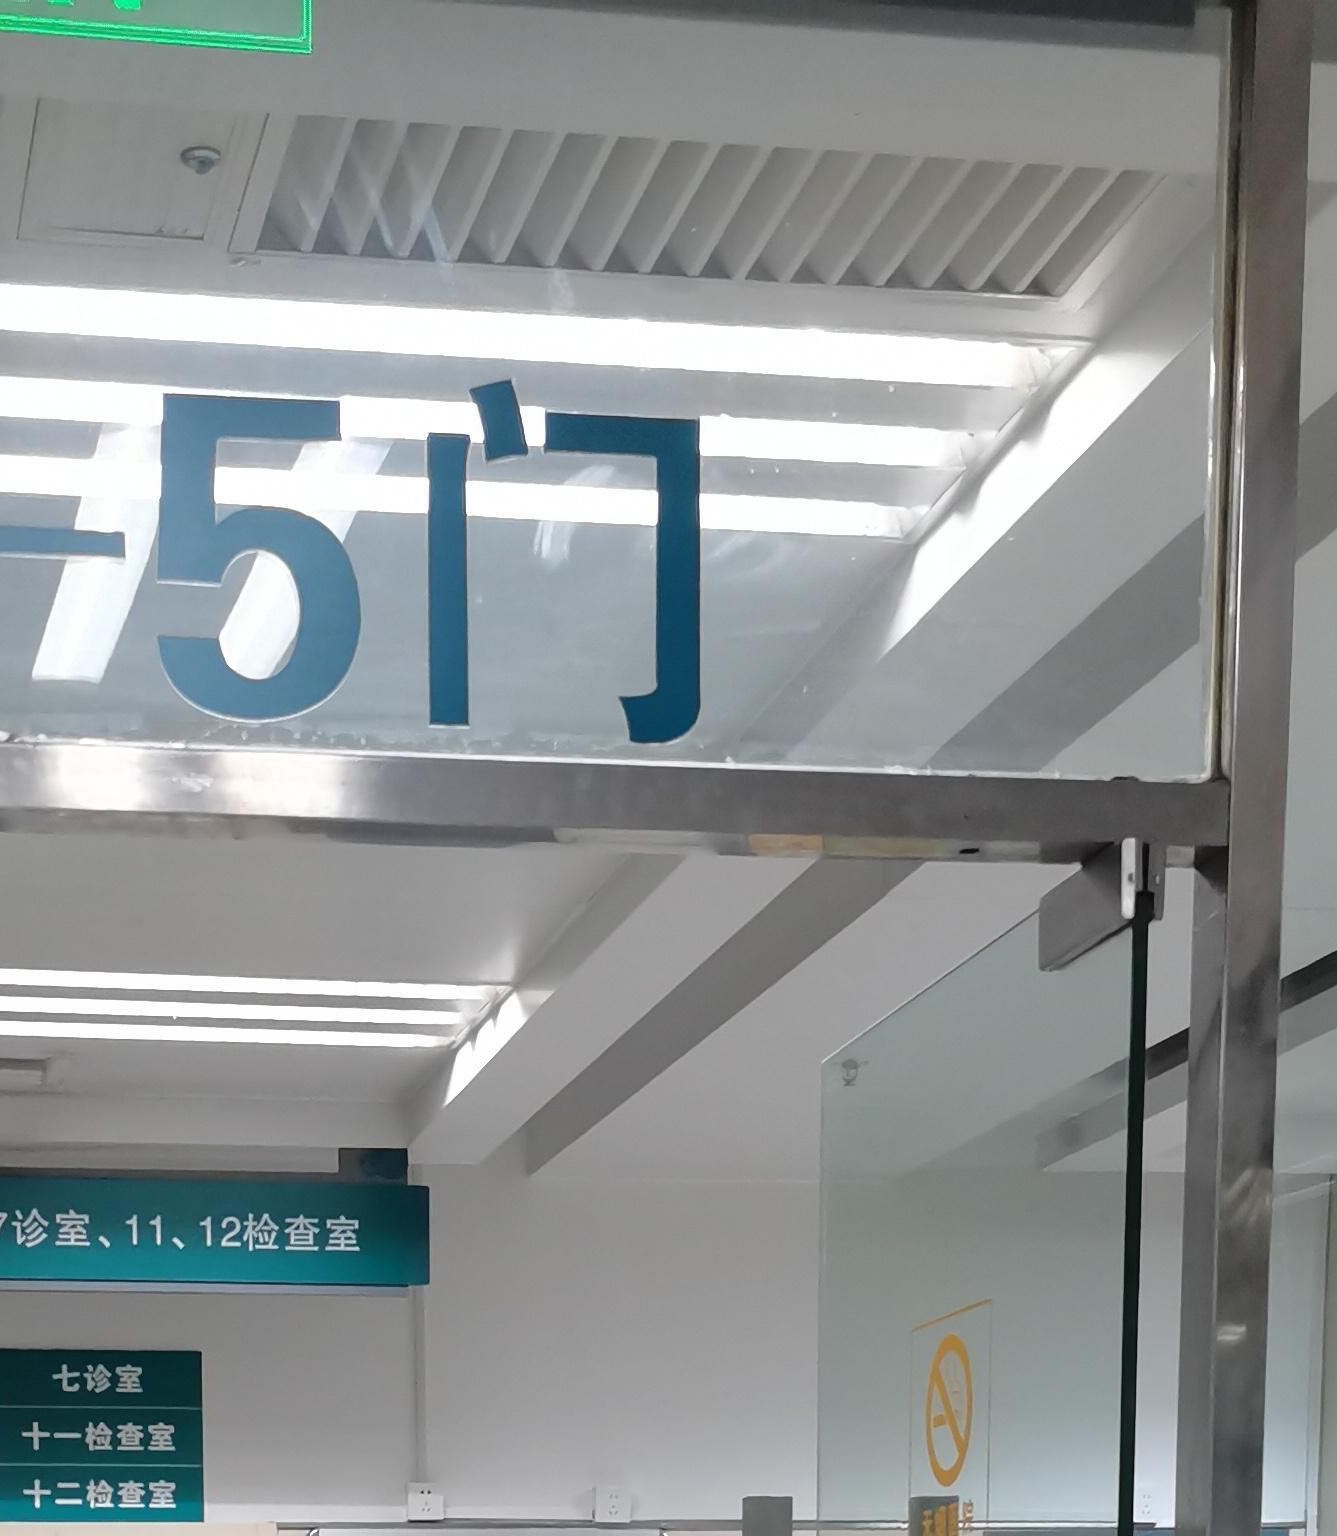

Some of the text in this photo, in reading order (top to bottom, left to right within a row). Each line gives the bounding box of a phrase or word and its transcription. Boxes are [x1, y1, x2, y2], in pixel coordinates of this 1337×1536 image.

[52, 1363, 144, 1394] 七诊室
[21, 1421, 177, 1453] 十一检查室
[22, 1478, 178, 1510] 十二检查室
